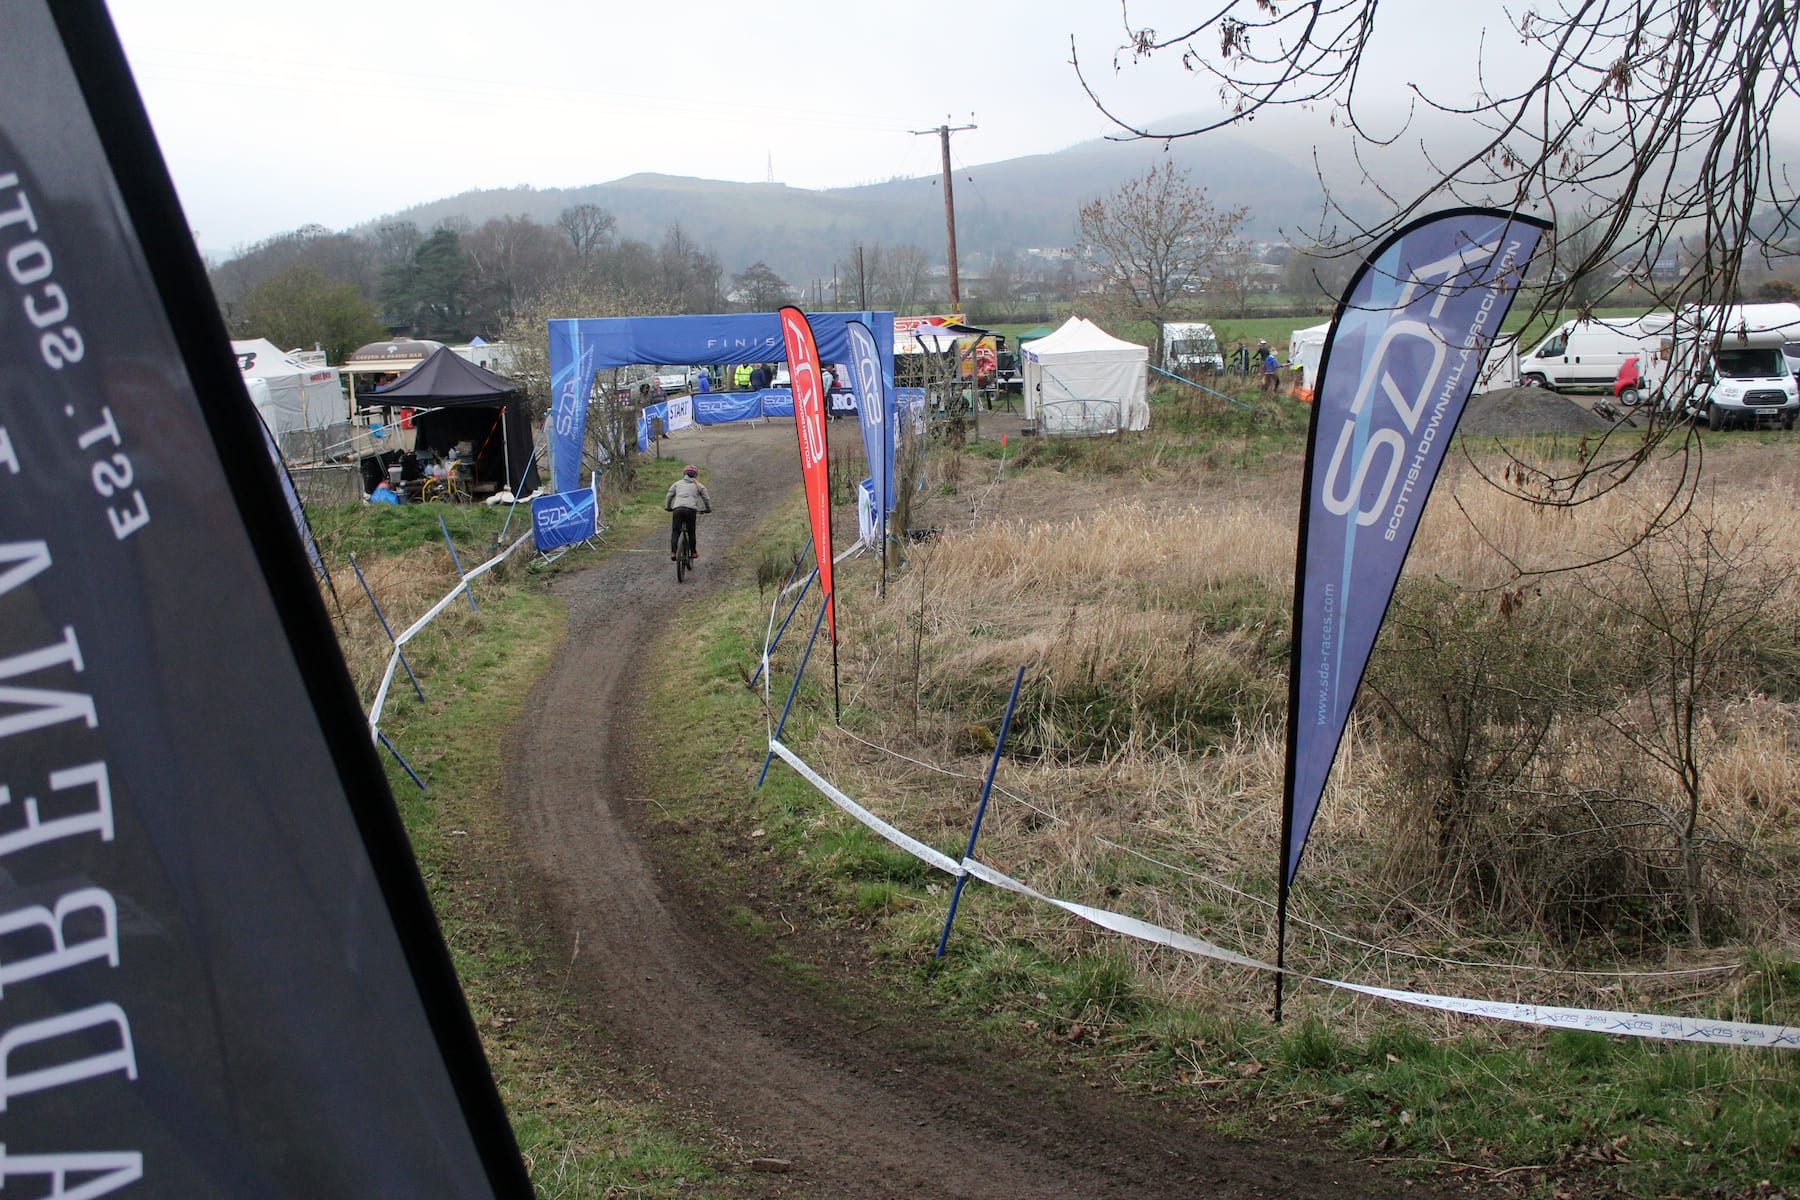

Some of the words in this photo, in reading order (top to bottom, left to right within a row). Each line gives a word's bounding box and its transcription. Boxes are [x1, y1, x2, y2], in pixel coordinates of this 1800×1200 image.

[707, 337, 785, 349] FINIS
[1322, 239, 1502, 526] SDA
[669, 400, 689, 420] START
[1384, 454, 1426, 541] SCOTTISH
[1419, 365, 1466, 460] DOWNHILL
[1461, 240, 1521, 363] ASSOCIATION
[538, 506, 570, 526] SDA
[1316, 583, 1335, 725] www.sda-races.com
